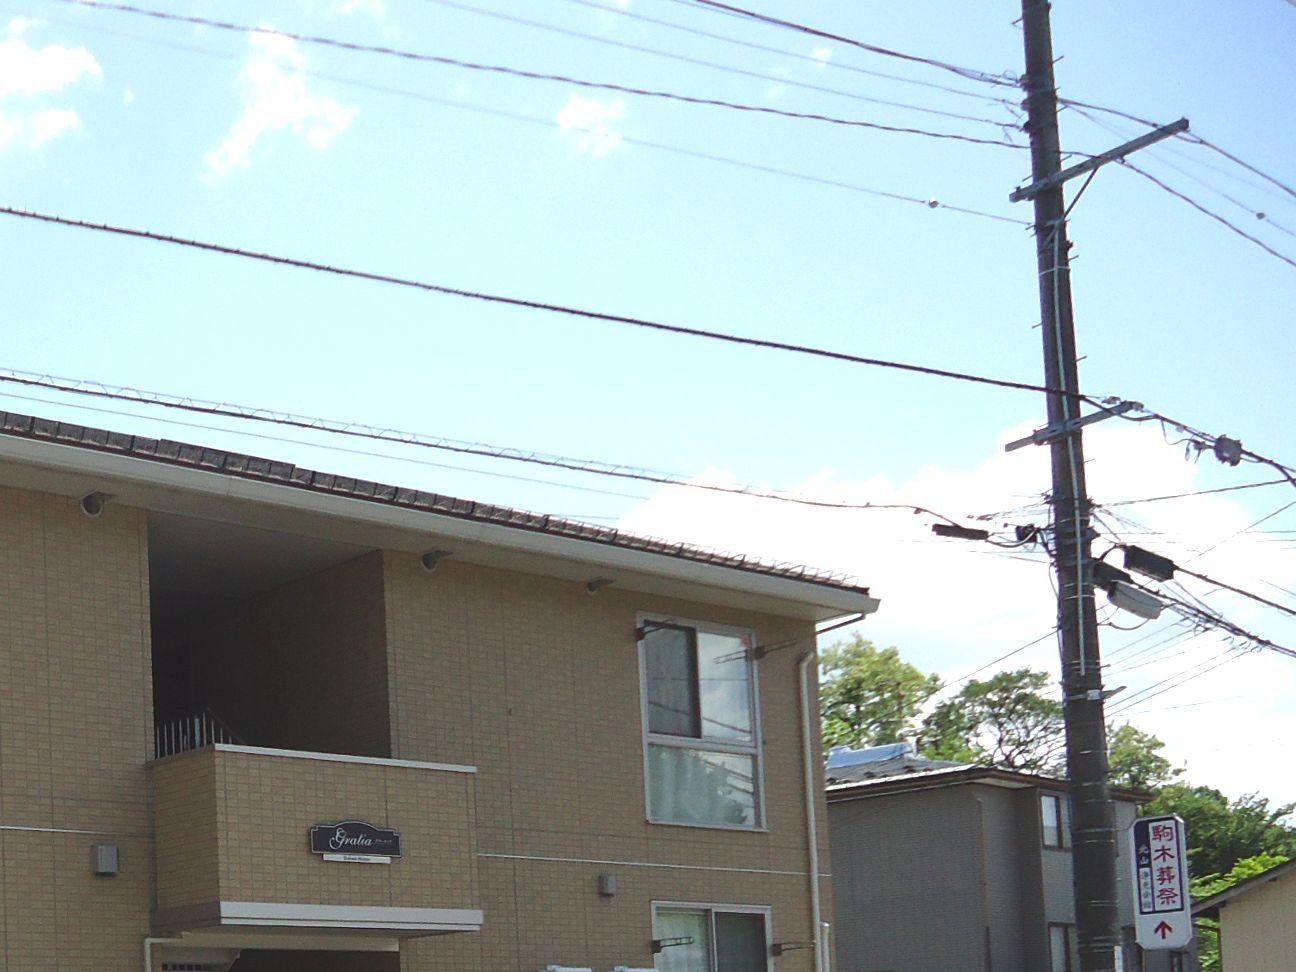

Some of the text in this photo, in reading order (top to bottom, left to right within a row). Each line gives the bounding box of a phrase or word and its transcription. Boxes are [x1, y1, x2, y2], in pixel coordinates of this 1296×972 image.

[329, 828, 373, 850] Gralia
[1152, 824, 1179, 906] 駒木葬祭
